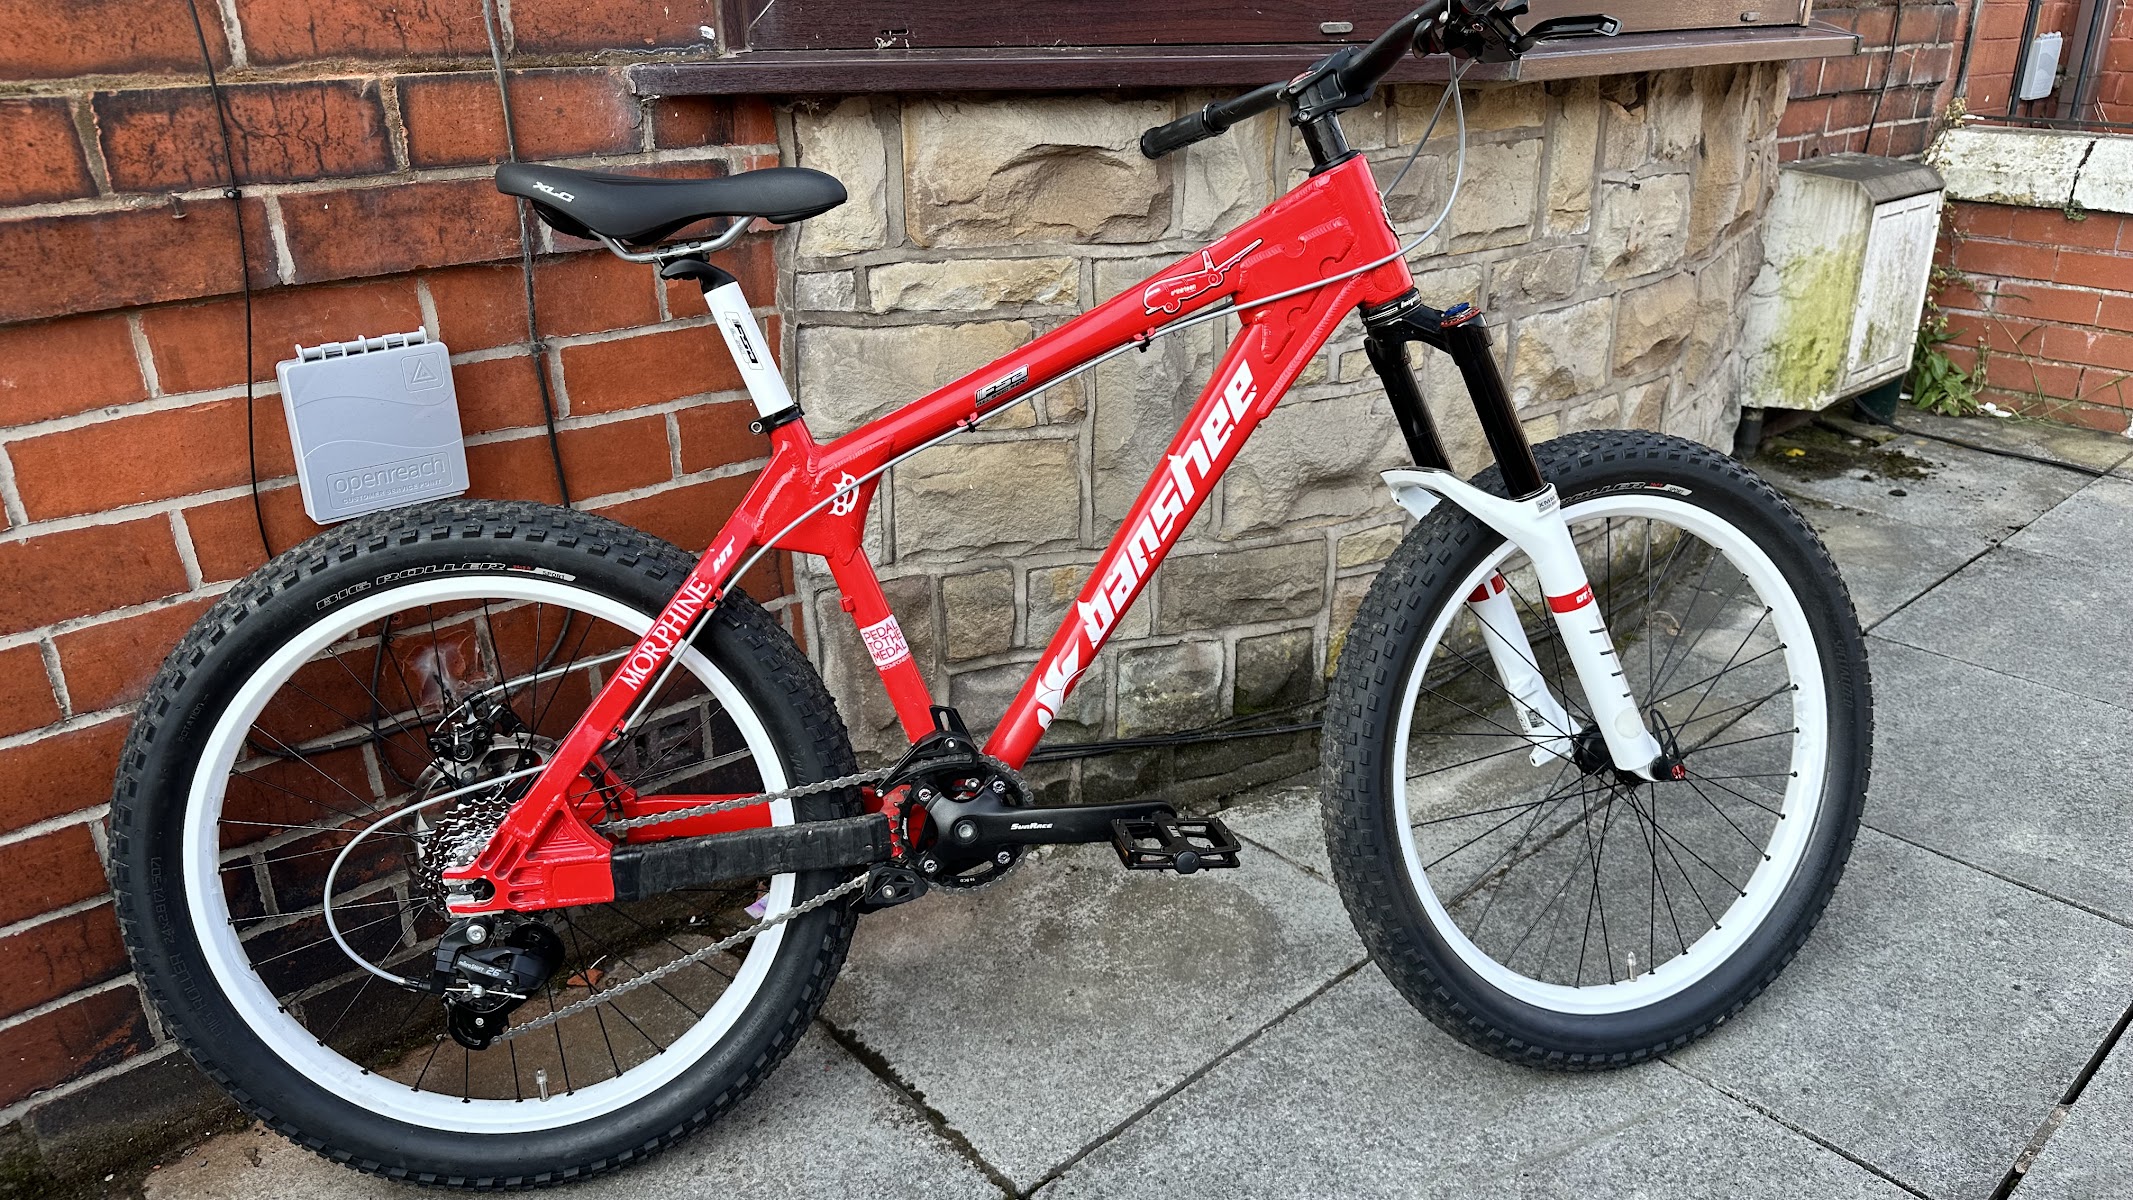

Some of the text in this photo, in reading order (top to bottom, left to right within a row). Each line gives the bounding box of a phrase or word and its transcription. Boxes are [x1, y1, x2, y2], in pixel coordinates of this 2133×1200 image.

[533, 181, 575, 202] XLC
[334, 457, 446, 495] openreach
[343, 478, 443, 504] CUSTOMER SERVICE POINT
[1077, 359, 1257, 650] banshee
[712, 535, 735, 574] HT
[316, 581, 371, 611] BIG
[376, 562, 506, 586] ROLLER
[619, 576, 713, 691] MORPHINE
[863, 620, 898, 642] PEDAL
[868, 628, 903, 653] TO THE
[872, 640, 907, 663] MEDAL
[168, 953, 207, 1012] ROLLER
[486, 966, 502, 977] 26
